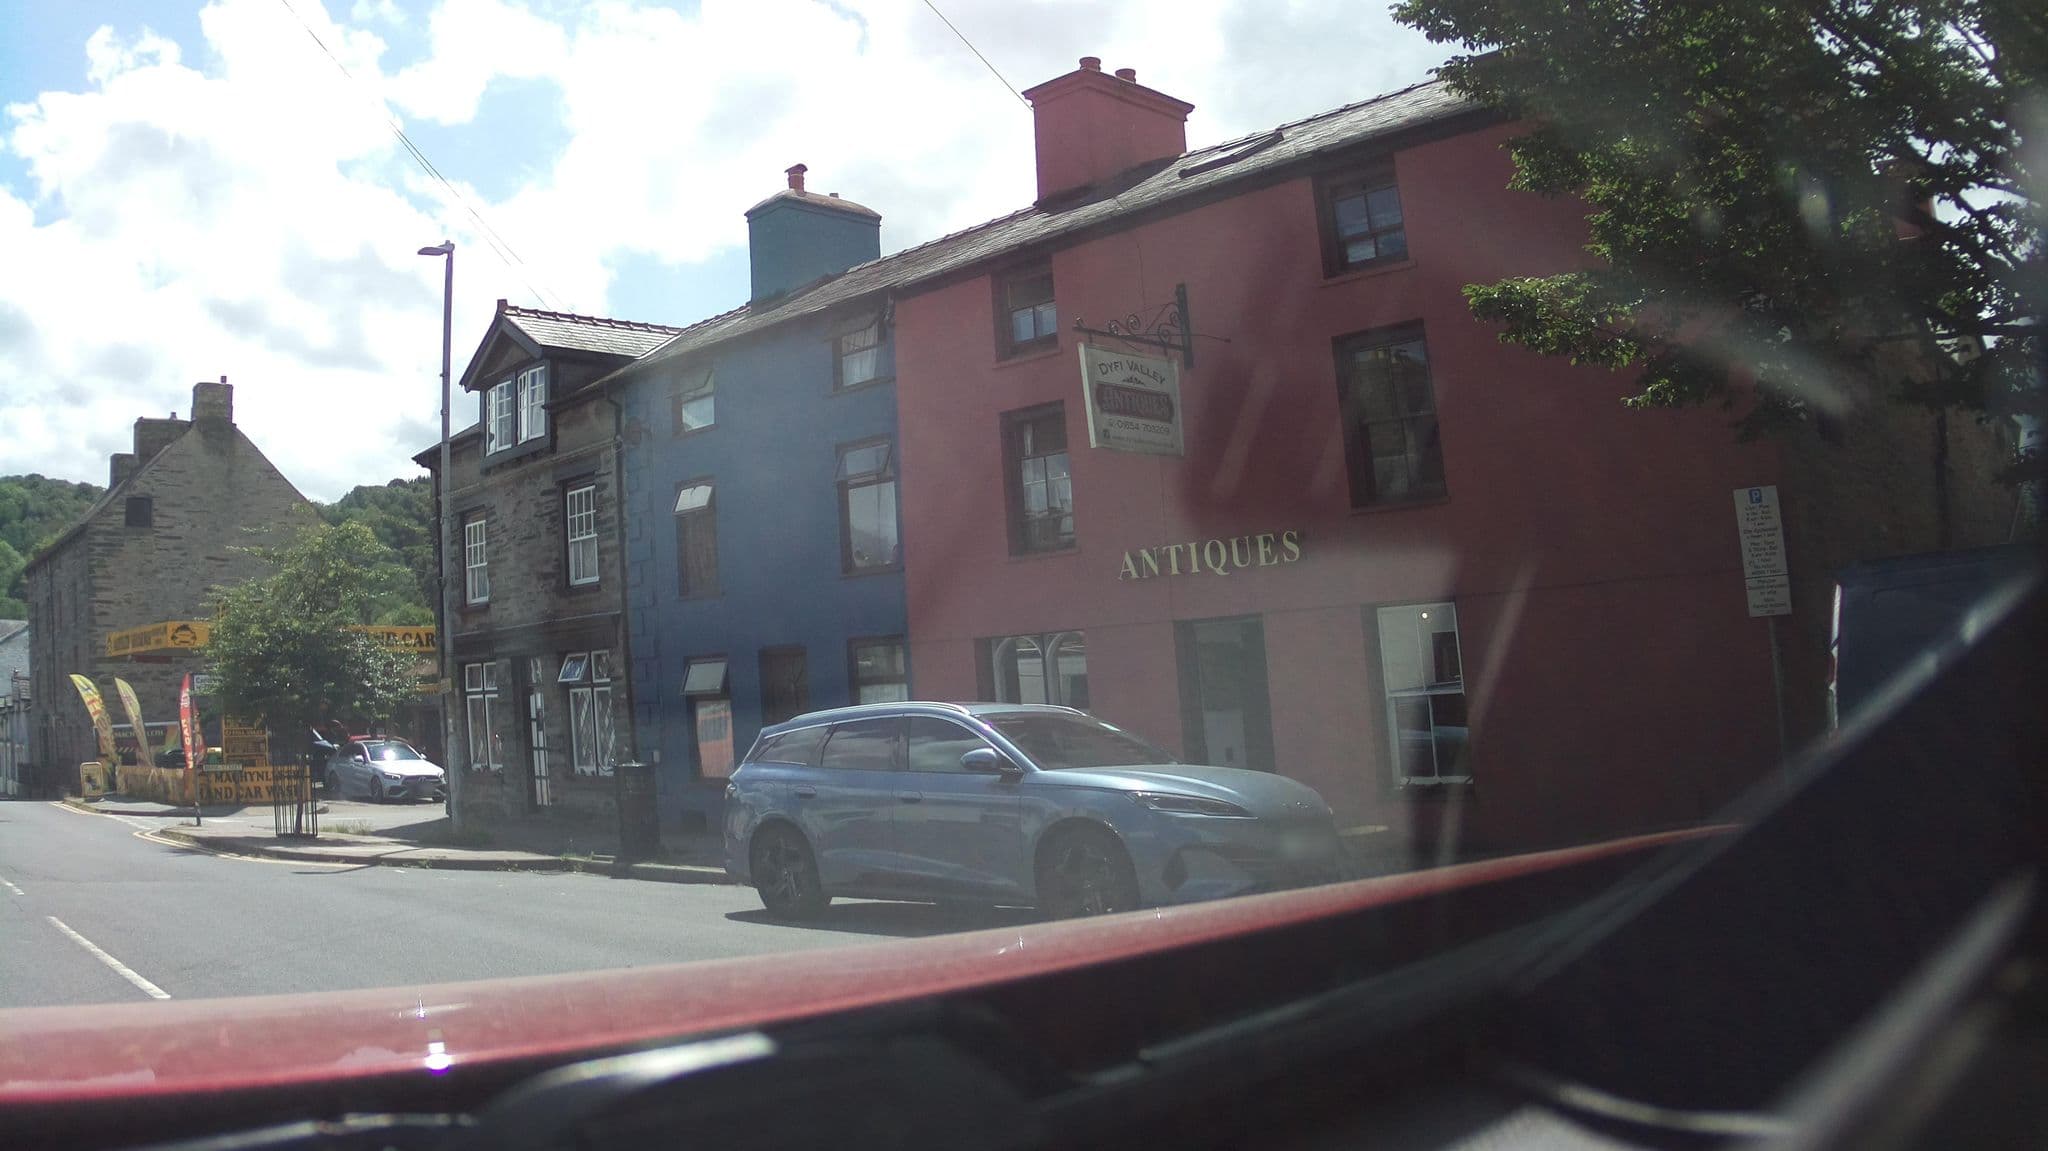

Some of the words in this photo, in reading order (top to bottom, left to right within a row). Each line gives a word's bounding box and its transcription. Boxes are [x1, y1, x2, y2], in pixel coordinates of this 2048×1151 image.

[1098, 360, 1123, 375] DYFI
[1126, 360, 1166, 384] VALLEY
[1751, 491, 1761, 503] P
[1118, 530, 1301, 580] ANTIQUES
[401, 631, 436, 649] CAR
